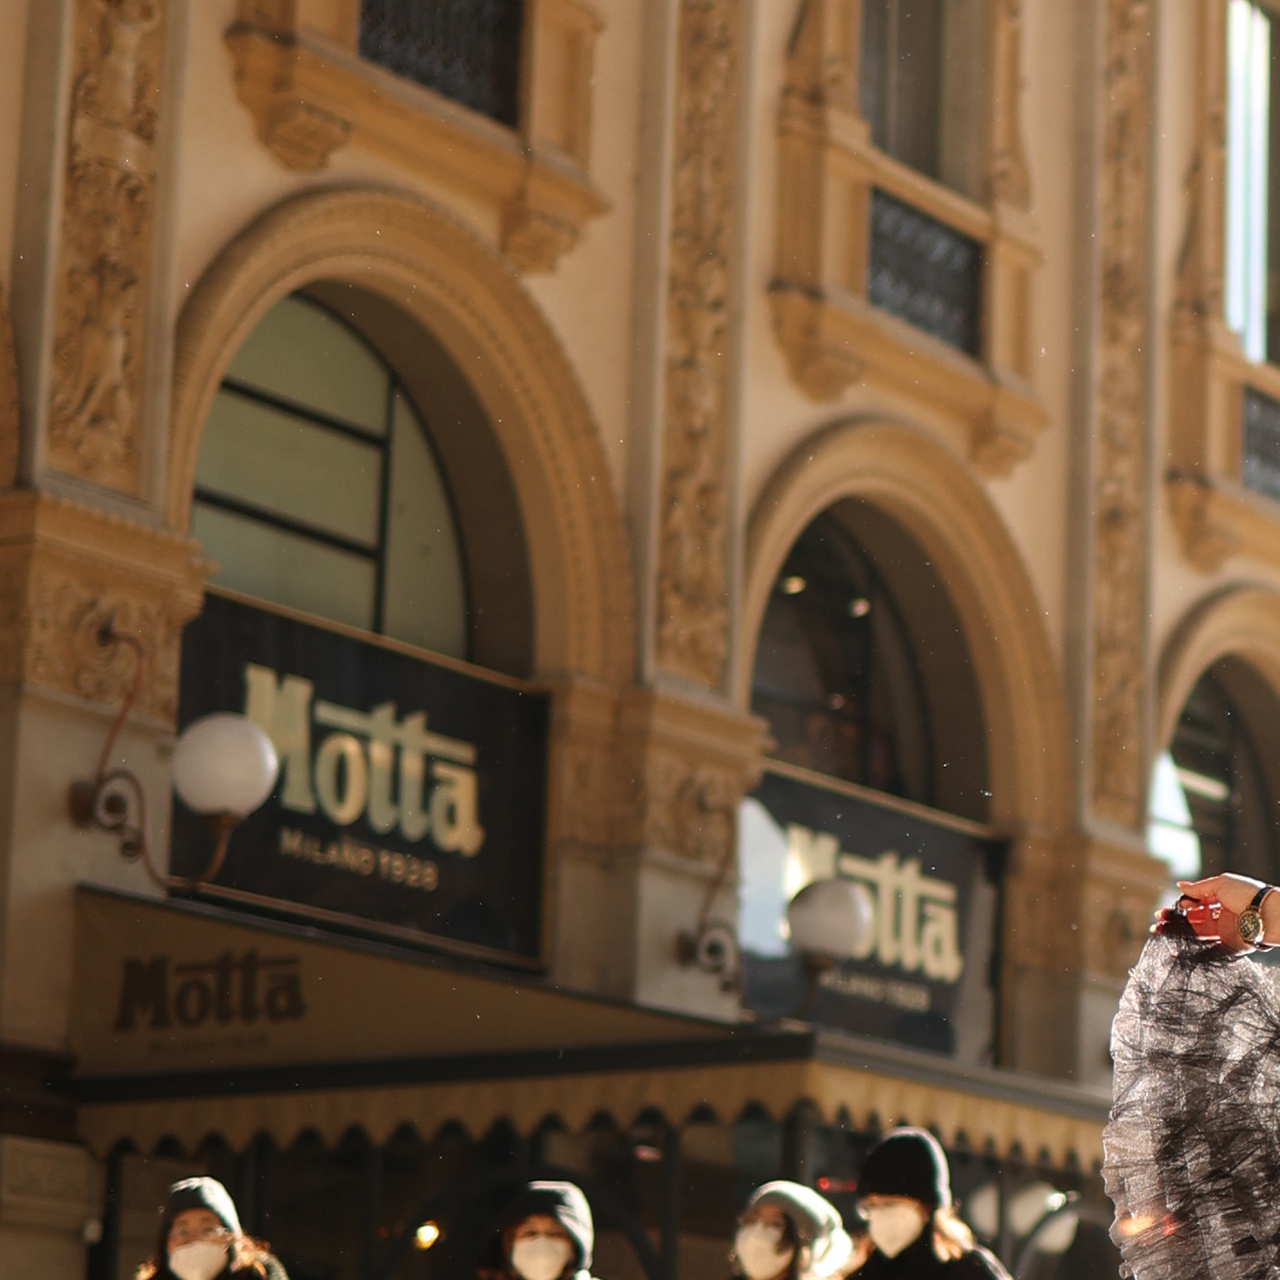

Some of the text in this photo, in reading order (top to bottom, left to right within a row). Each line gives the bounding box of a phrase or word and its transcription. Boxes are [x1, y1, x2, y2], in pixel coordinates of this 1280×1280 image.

[246, 661, 485, 857] Motta
[280, 826, 438, 892] MILANO 1928
[114, 947, 308, 1033] Motta
